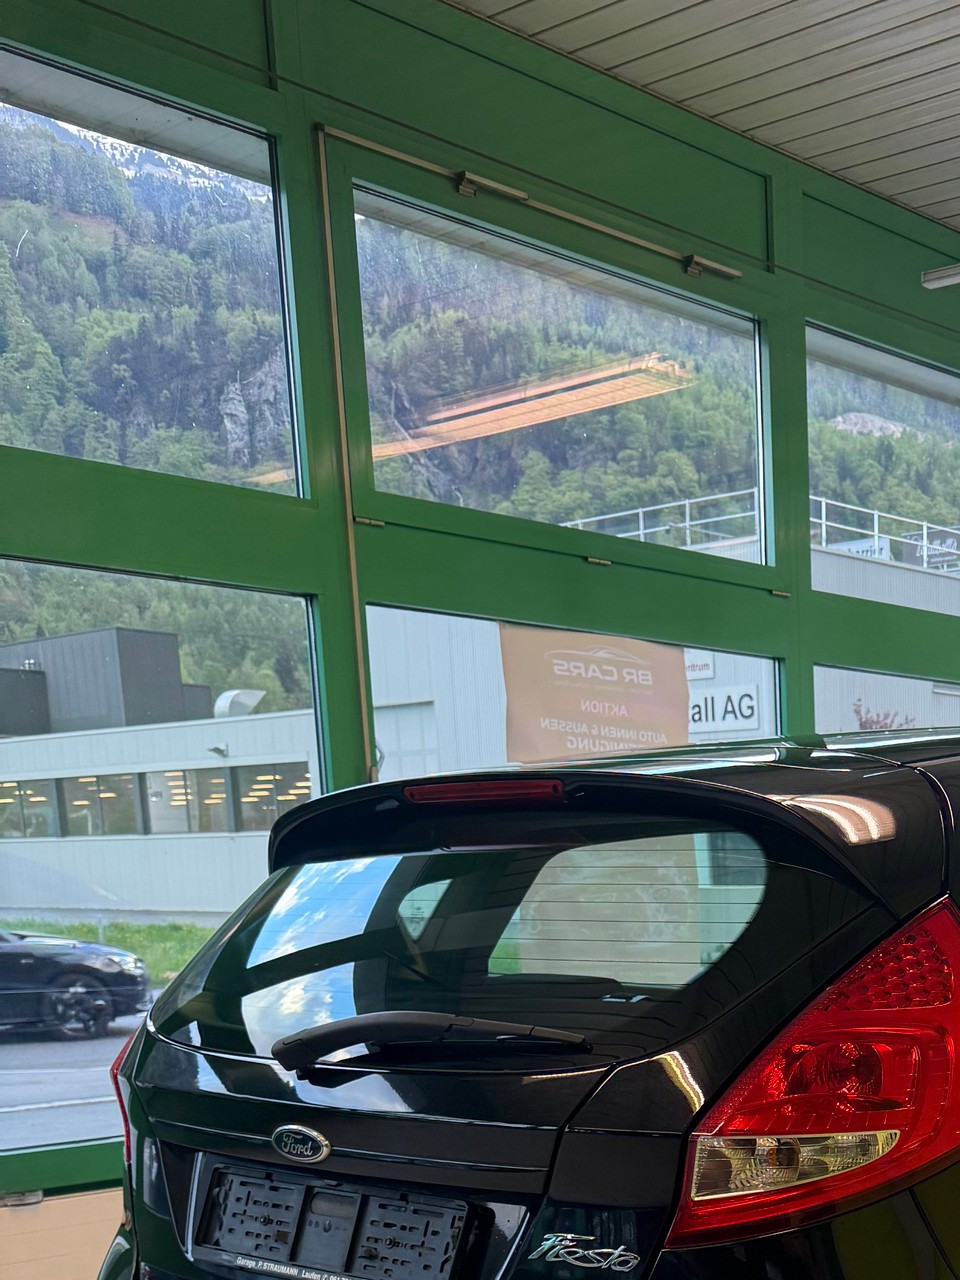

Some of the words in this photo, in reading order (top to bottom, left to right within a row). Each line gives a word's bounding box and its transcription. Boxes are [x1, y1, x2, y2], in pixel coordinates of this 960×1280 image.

[690, 696, 715, 723] all
[722, 693, 755, 720] AG
[282, 1132, 313, 1156] Ford
[528, 1233, 640, 1272] Fiesta
[236, 1256, 256, 1268] Garage
[301, 1269, 321, 1280] Laufen
